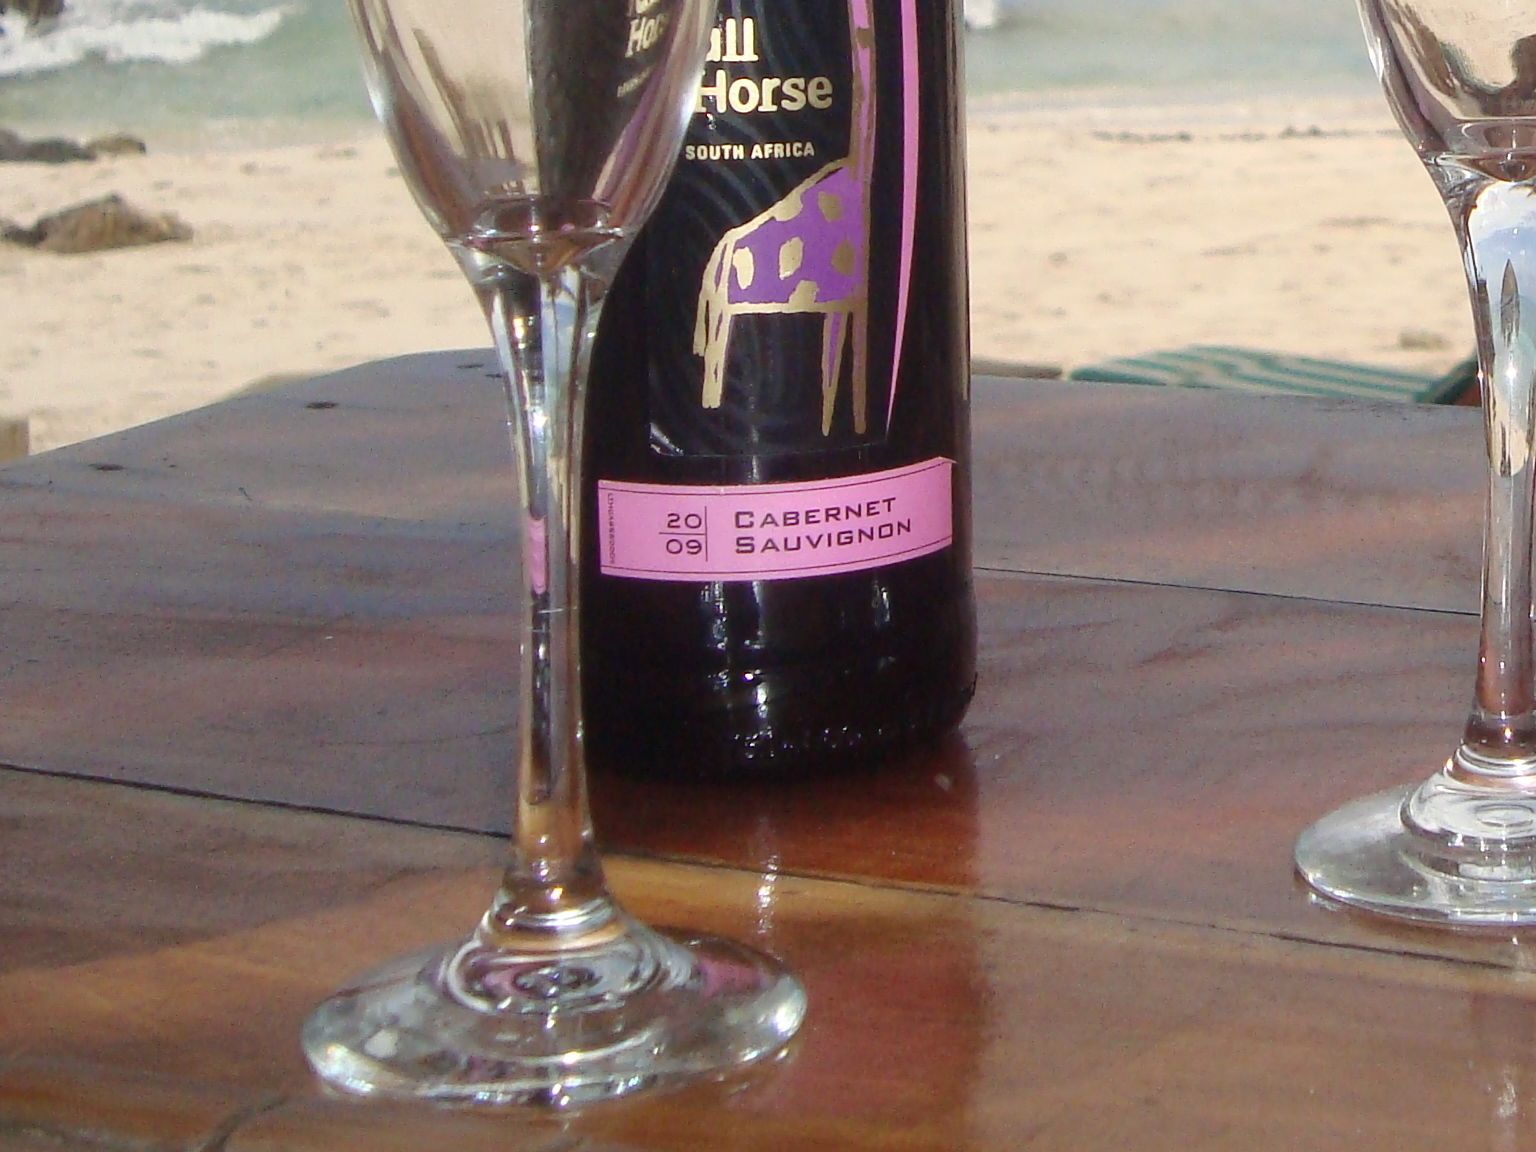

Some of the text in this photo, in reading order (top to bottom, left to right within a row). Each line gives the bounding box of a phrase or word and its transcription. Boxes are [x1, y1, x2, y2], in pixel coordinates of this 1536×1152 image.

[694, 69, 833, 114] Horse
[685, 141, 815, 160] SOUTH AFRICA
[667, 512, 702, 529] 20
[666, 538, 703, 555] 09
